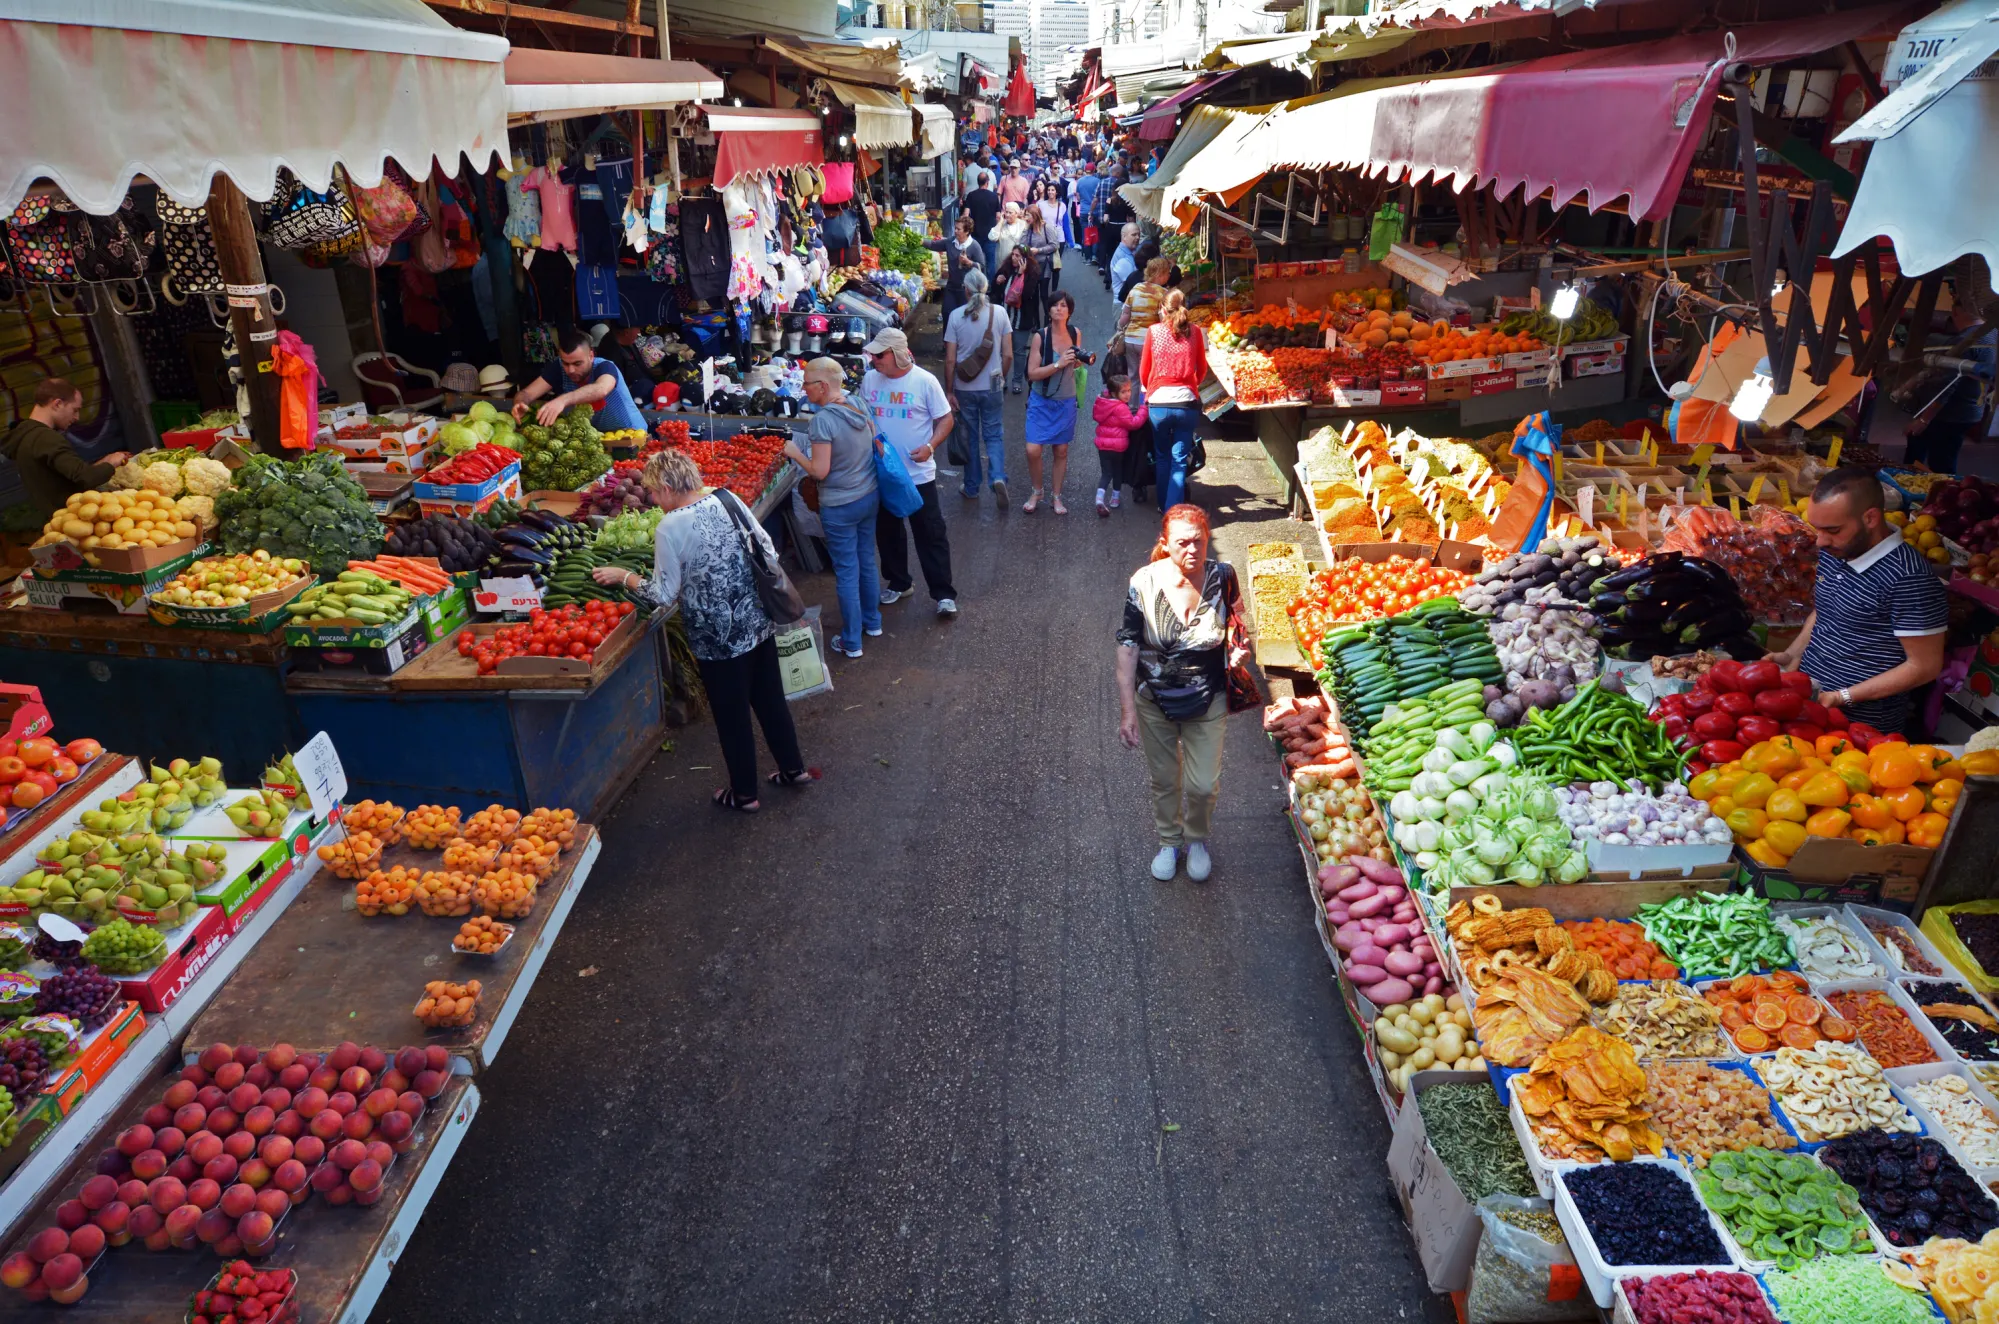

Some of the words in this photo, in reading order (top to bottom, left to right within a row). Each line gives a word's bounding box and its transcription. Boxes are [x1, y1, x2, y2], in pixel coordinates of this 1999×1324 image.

[1908, 39, 1945, 58] זוהר
[192, 543, 210, 558] בננות
[511, 597, 539, 606] ברעם
[315, 778, 334, 803] 7
